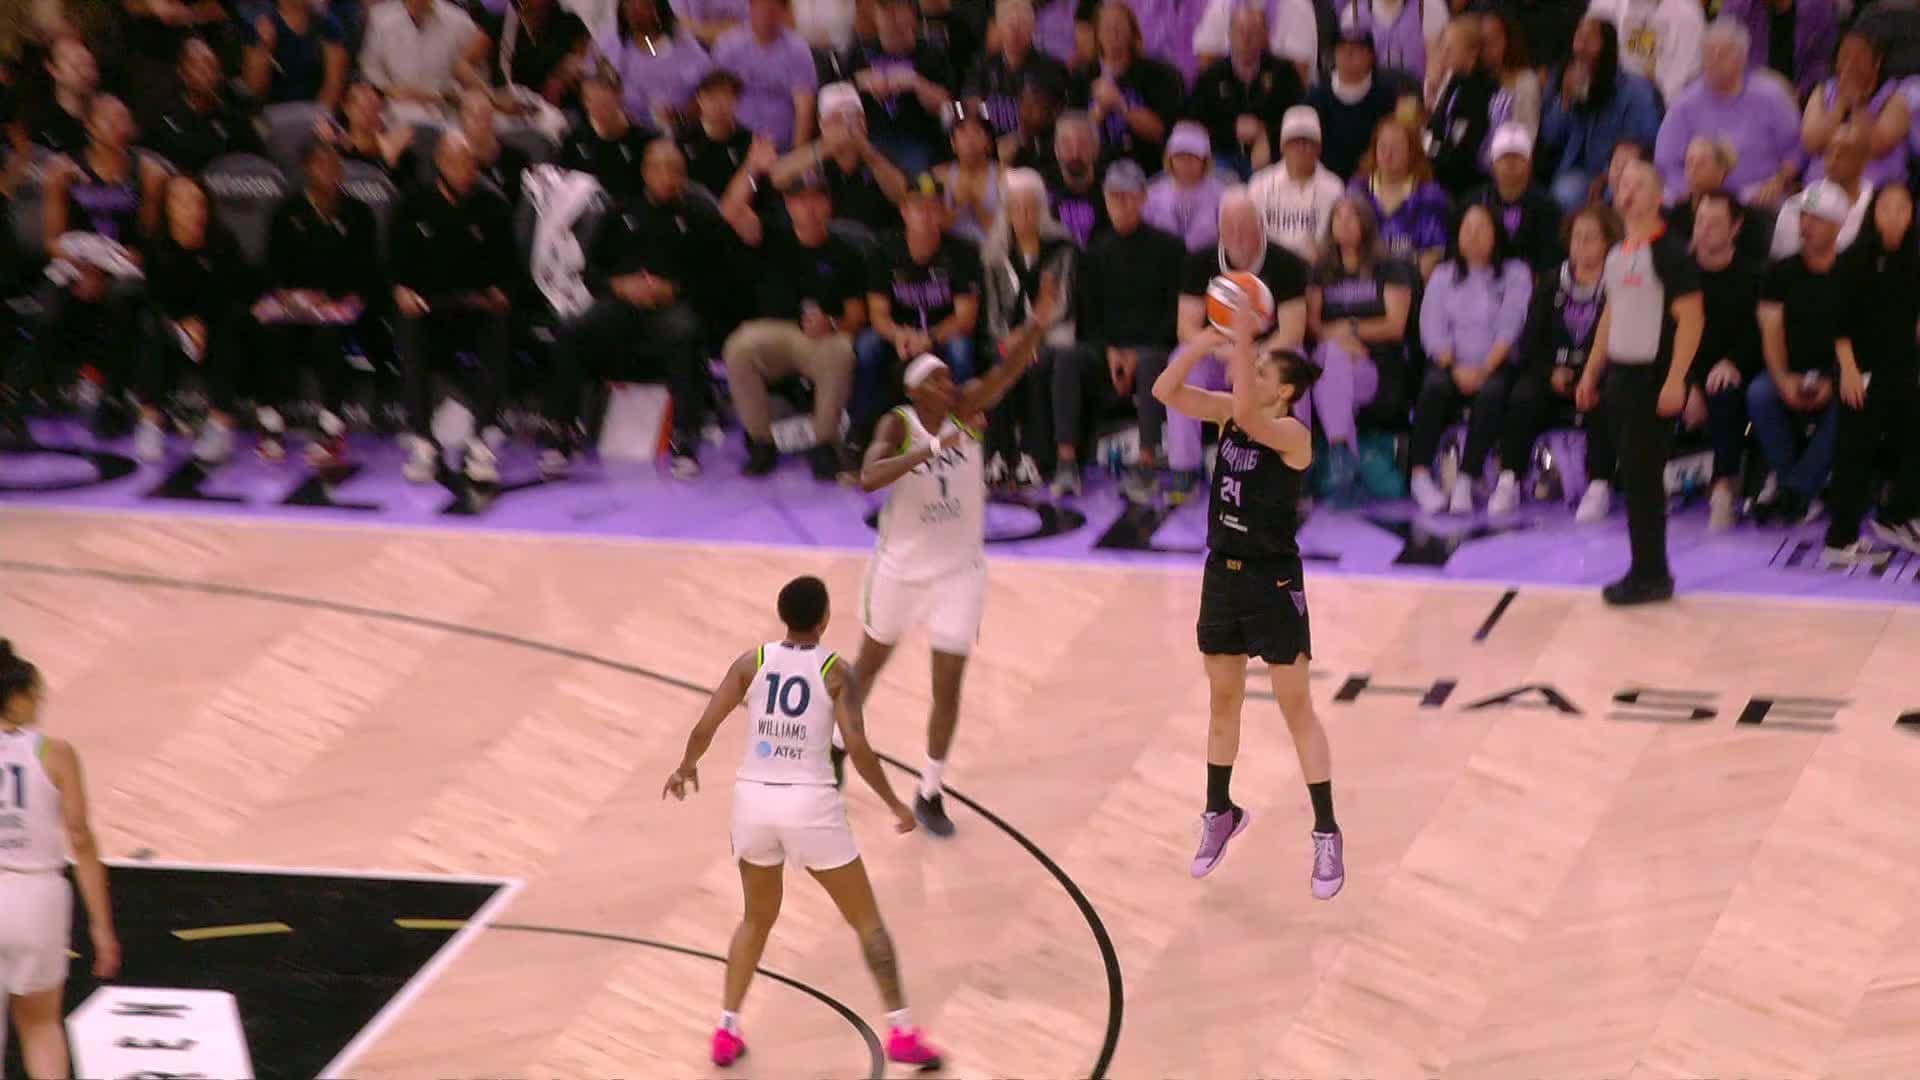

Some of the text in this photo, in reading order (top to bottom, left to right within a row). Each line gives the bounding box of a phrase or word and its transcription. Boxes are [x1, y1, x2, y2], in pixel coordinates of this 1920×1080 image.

[1220, 476, 1242, 507] 24
[765, 672, 811, 718] 10
[758, 719, 807, 741] WILLIAMS
[774, 745, 804, 760] AT&T
[0, 763, 26, 809] 1
